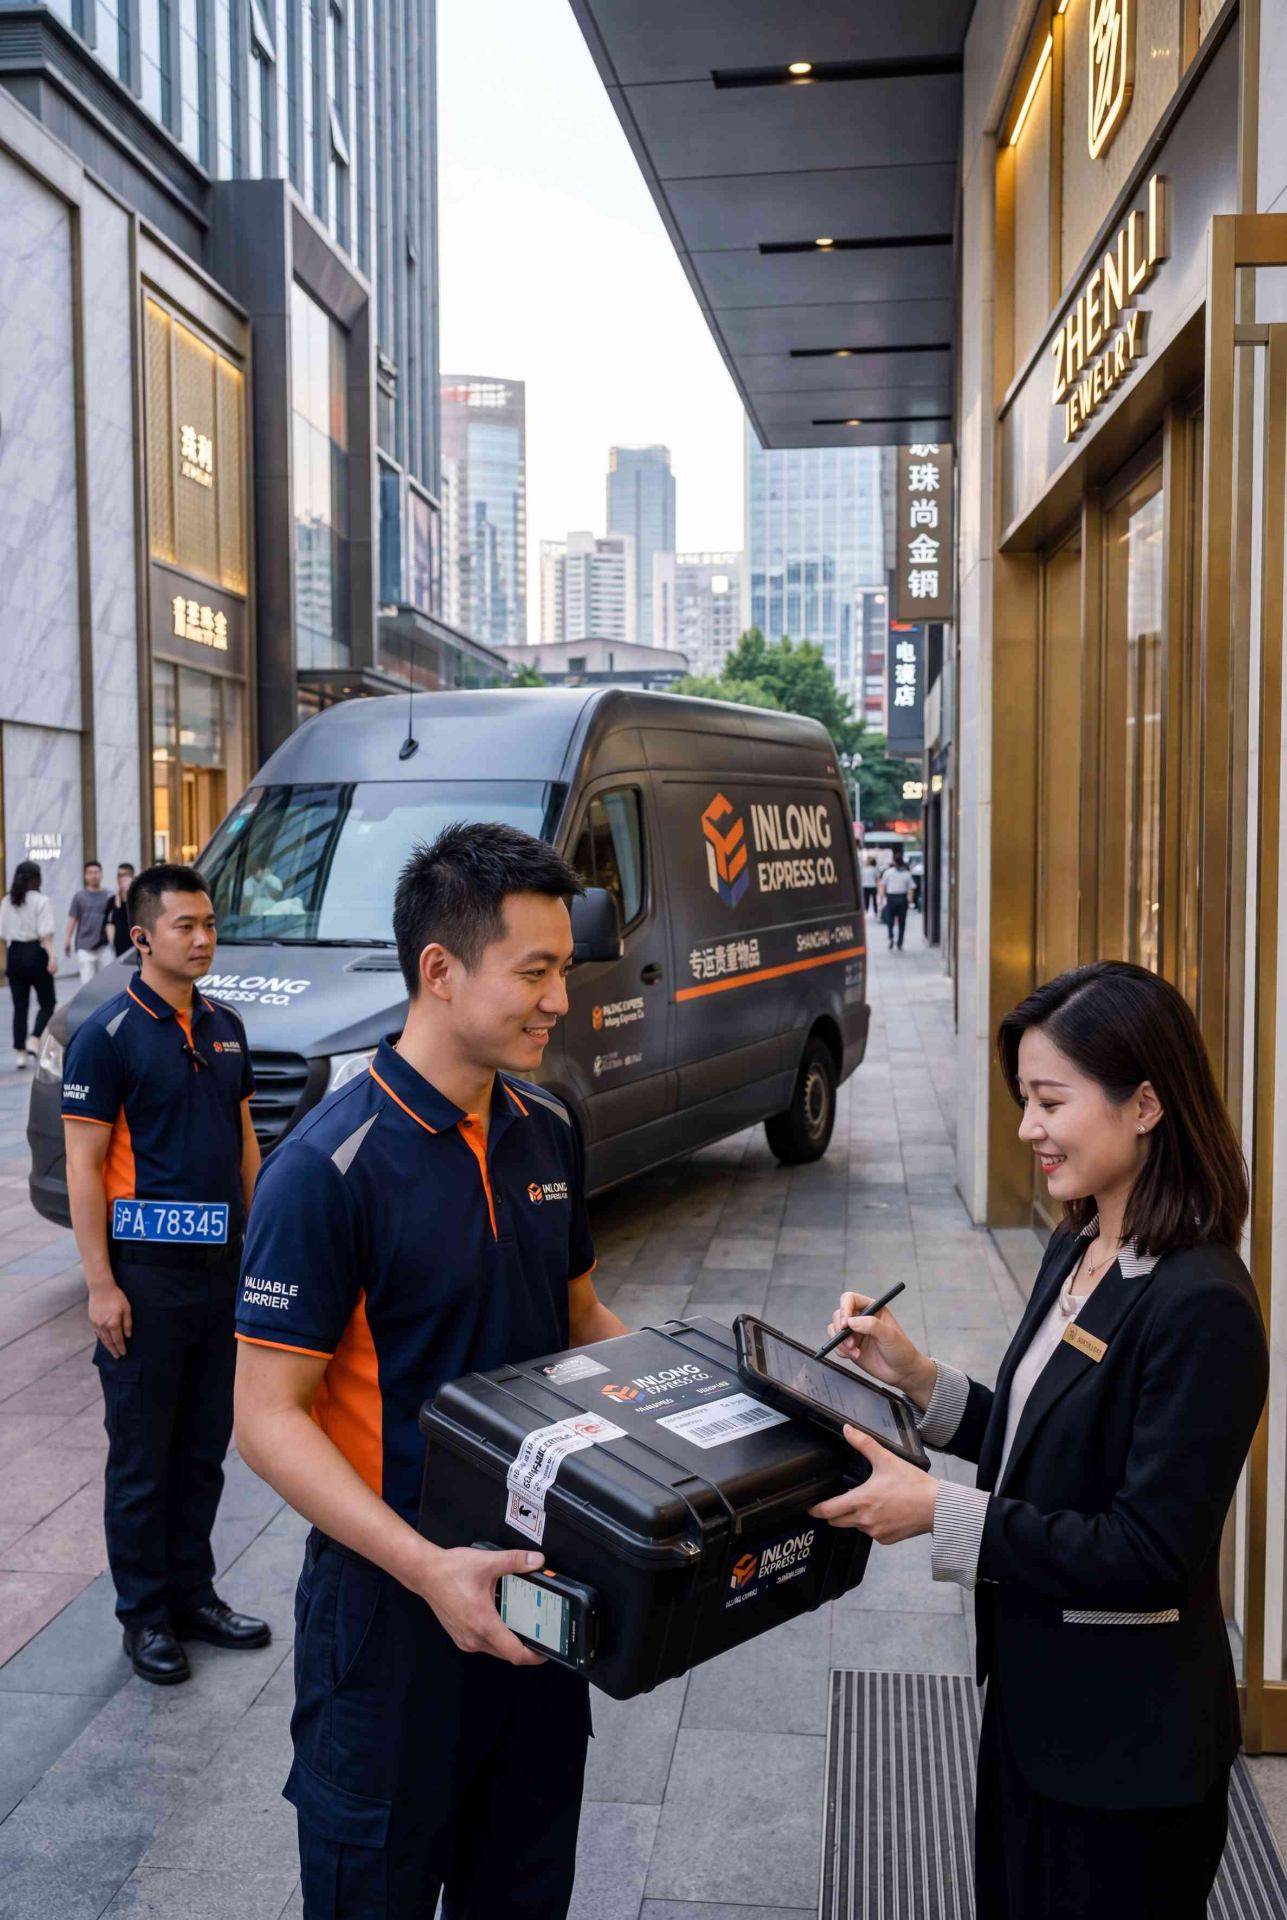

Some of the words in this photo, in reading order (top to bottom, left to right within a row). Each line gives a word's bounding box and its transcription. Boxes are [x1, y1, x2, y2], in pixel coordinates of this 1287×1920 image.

[1051, 174, 1165, 405] ZHENLI
[1064, 311, 1145, 444] JEWELRY
[751, 804, 832, 852] INLONG
[758, 860, 816, 892] EXPRESS
[817, 857, 837, 885] CO.
[688, 938, 761, 979] 专运贵重物品
[200, 989, 259, 1002] PRESS
[259, 994, 290, 1006] CO.
[154, 1209, 225, 1237] 78345
[243, 1290, 289, 1310] CARRIER
[632, 1364, 701, 1389] INLONG
[760, 1529, 815, 1567] INLONG
[758, 1553, 796, 1579] EXPRESS
